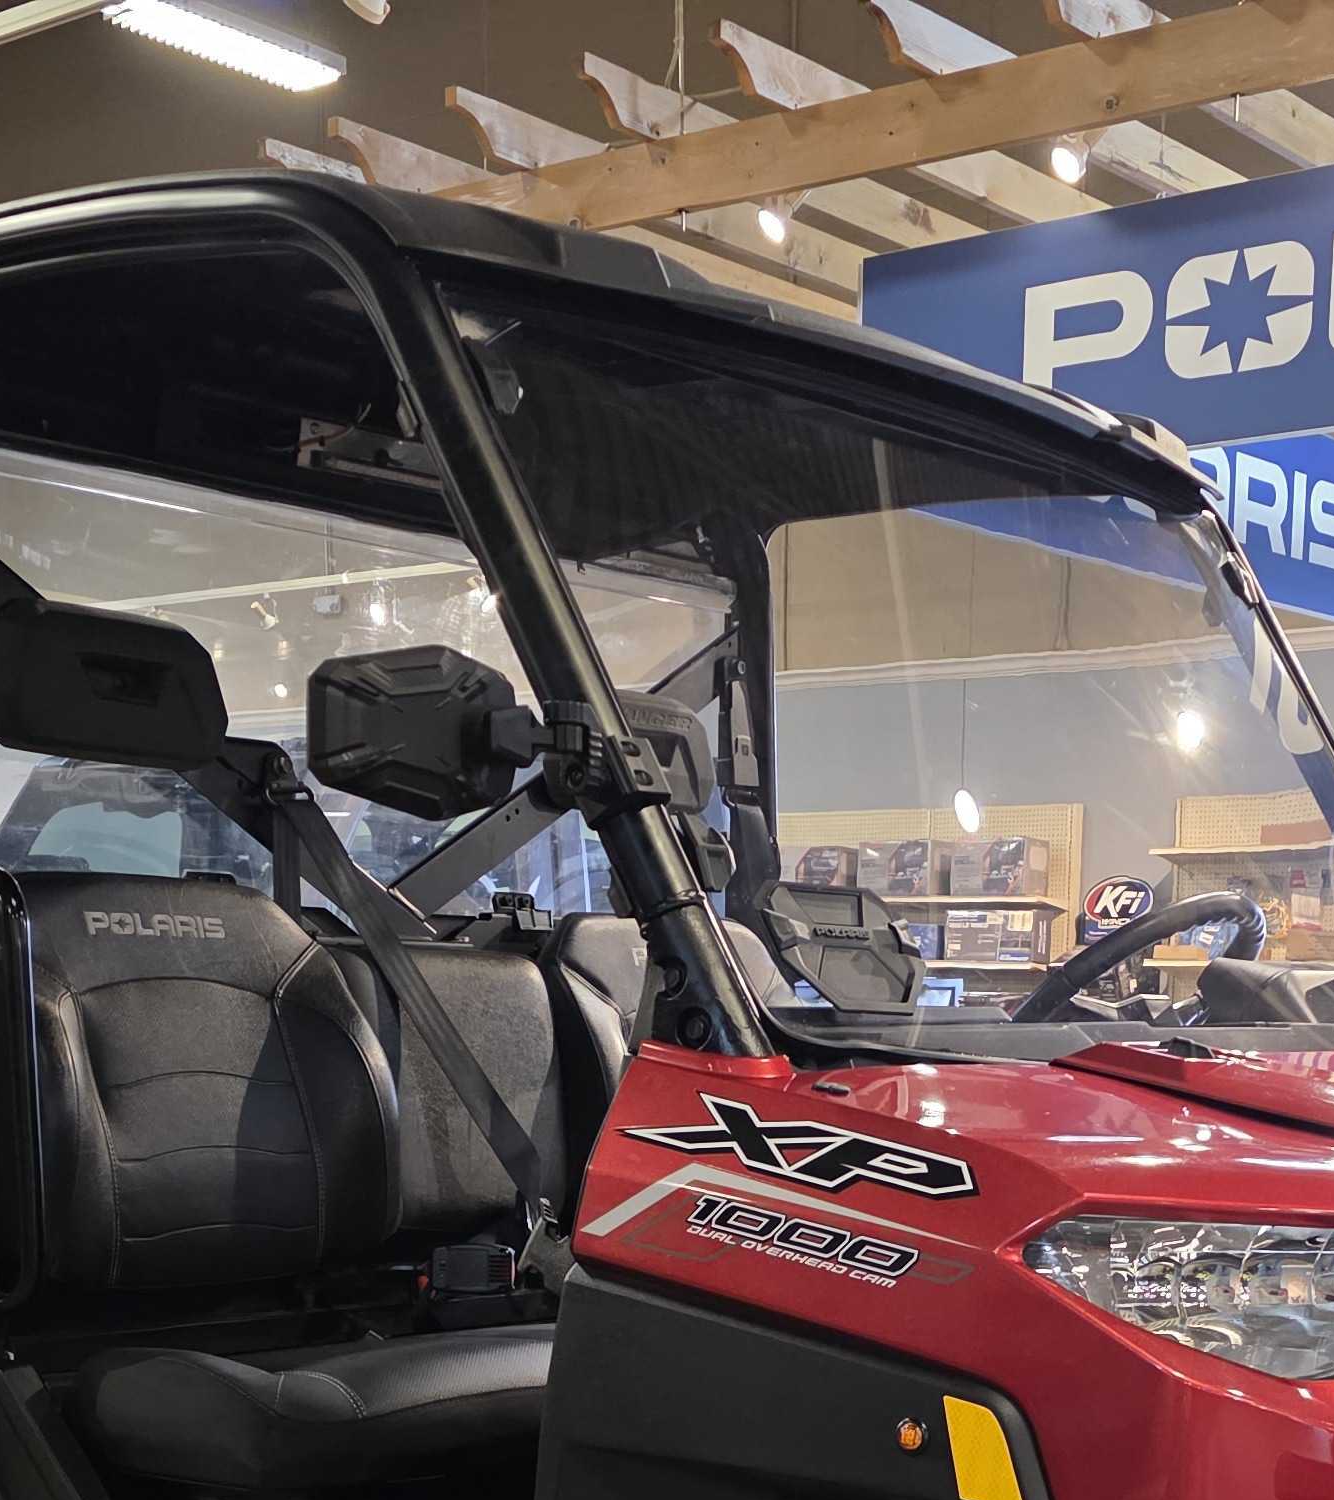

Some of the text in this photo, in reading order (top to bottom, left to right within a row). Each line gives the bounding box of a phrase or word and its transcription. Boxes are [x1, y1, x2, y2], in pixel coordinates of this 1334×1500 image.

[83, 911, 226, 939] POLARIS
[616, 1090, 981, 1200] XP
[686, 1225, 898, 1289] DUAL OVERHEAD CAM
[687, 1194, 920, 1277] 1000
